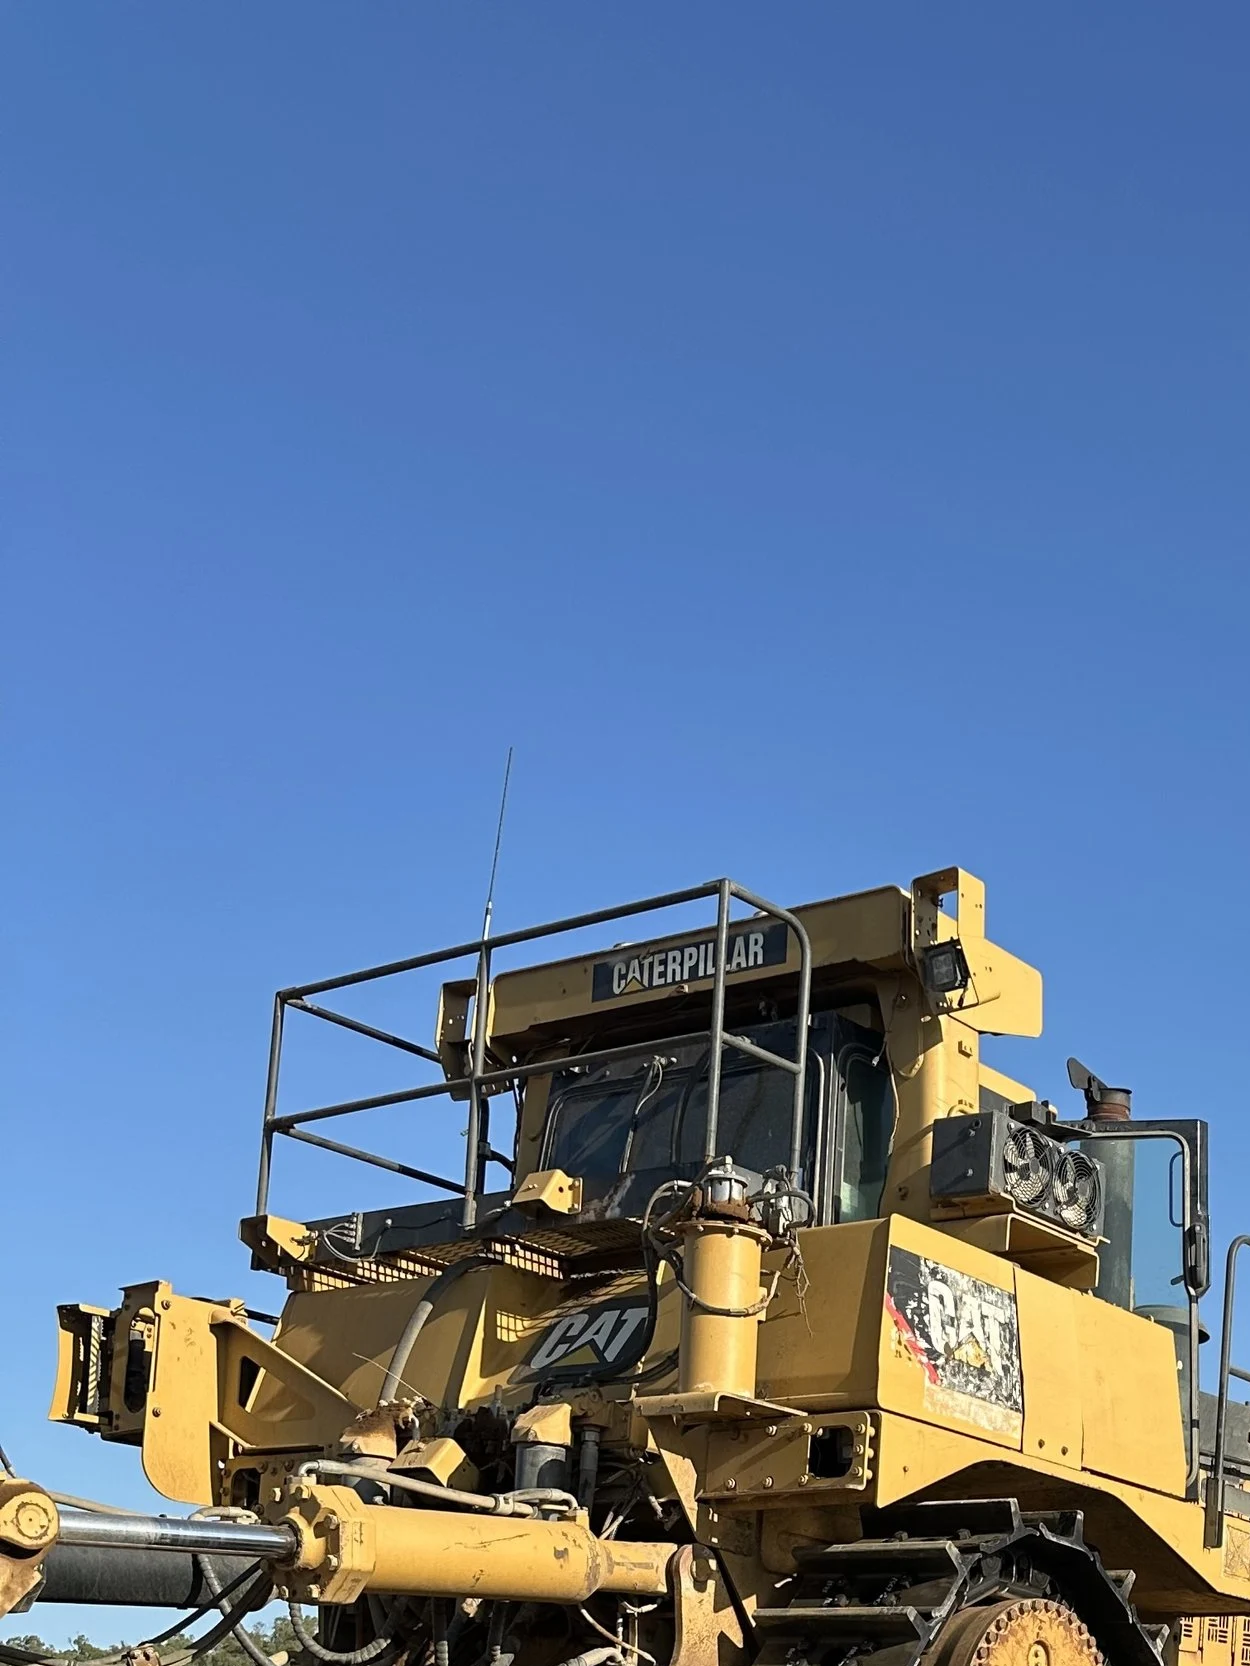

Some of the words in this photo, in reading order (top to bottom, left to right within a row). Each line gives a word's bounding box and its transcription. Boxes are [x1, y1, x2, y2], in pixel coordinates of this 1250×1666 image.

[612, 932, 764, 995] CATERPILAR
[530, 1307, 649, 1369] CAT
[928, 1279, 1006, 1377] CAT
